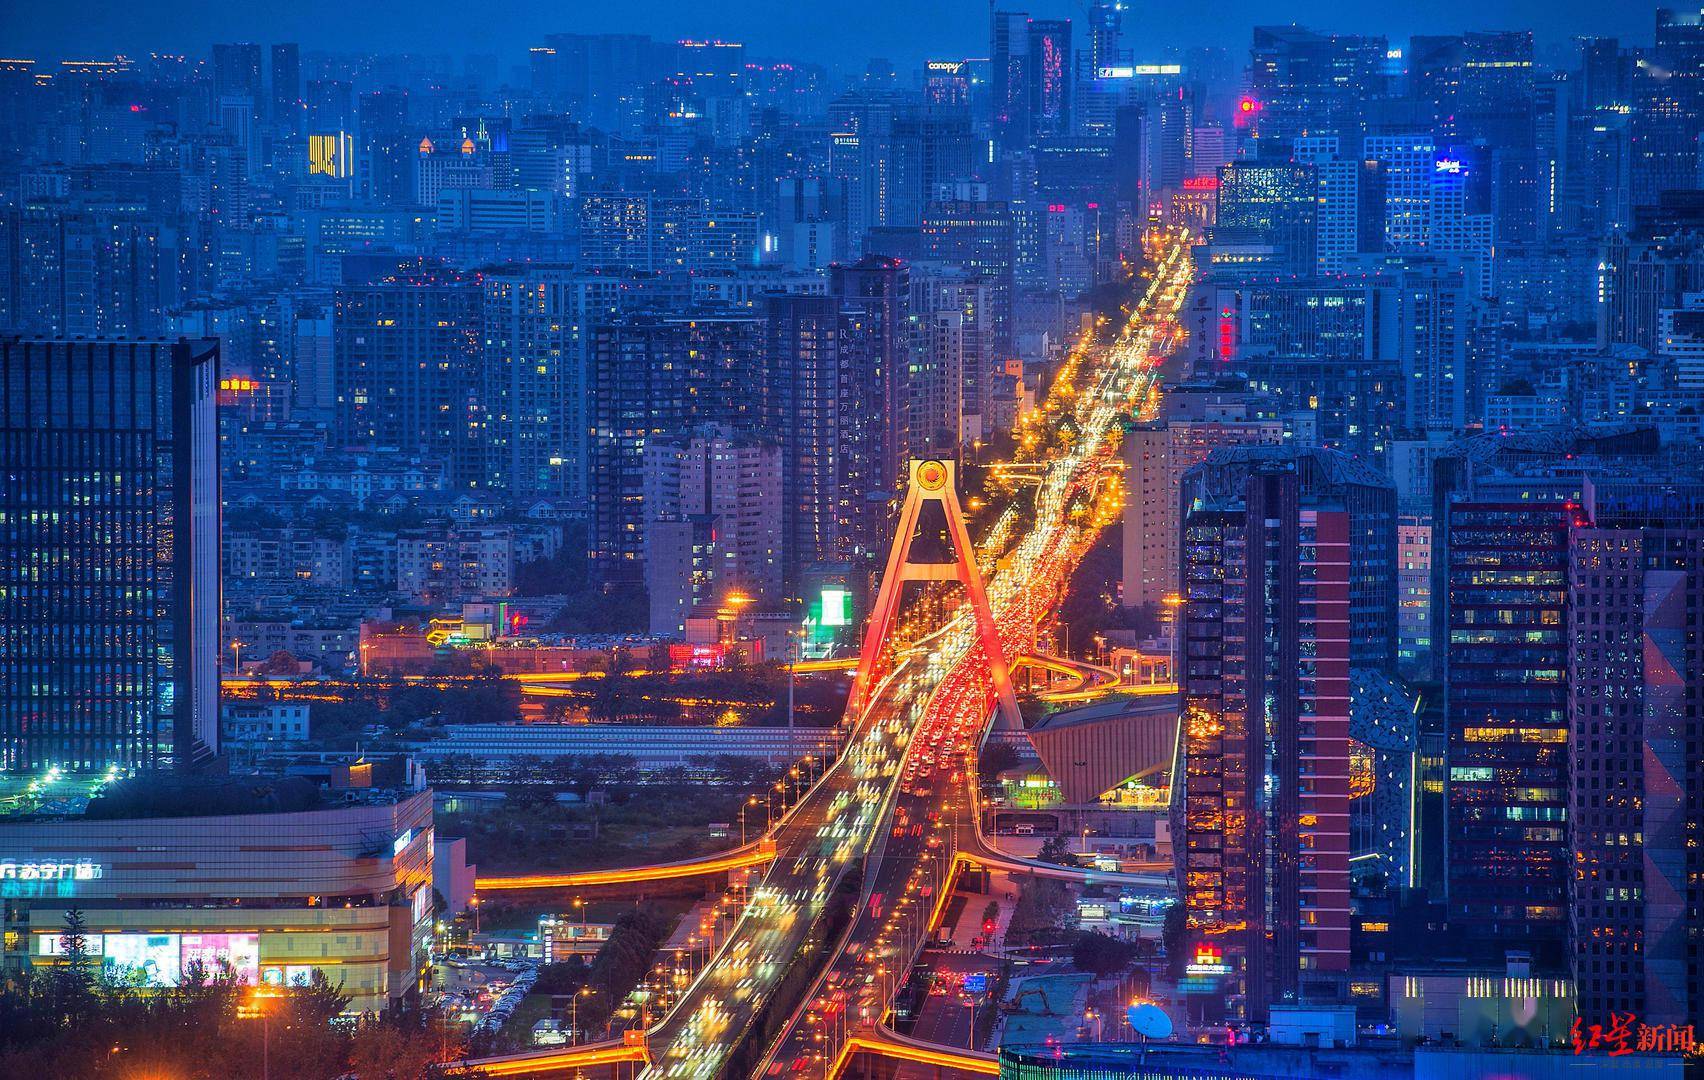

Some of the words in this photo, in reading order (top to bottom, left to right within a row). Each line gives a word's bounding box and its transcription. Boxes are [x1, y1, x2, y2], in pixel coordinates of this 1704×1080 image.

[928, 62, 963, 74] canopy
[839, 346, 849, 454] 成都首座万丽酒店
[20, 864, 103, 880] 苏宁广场
